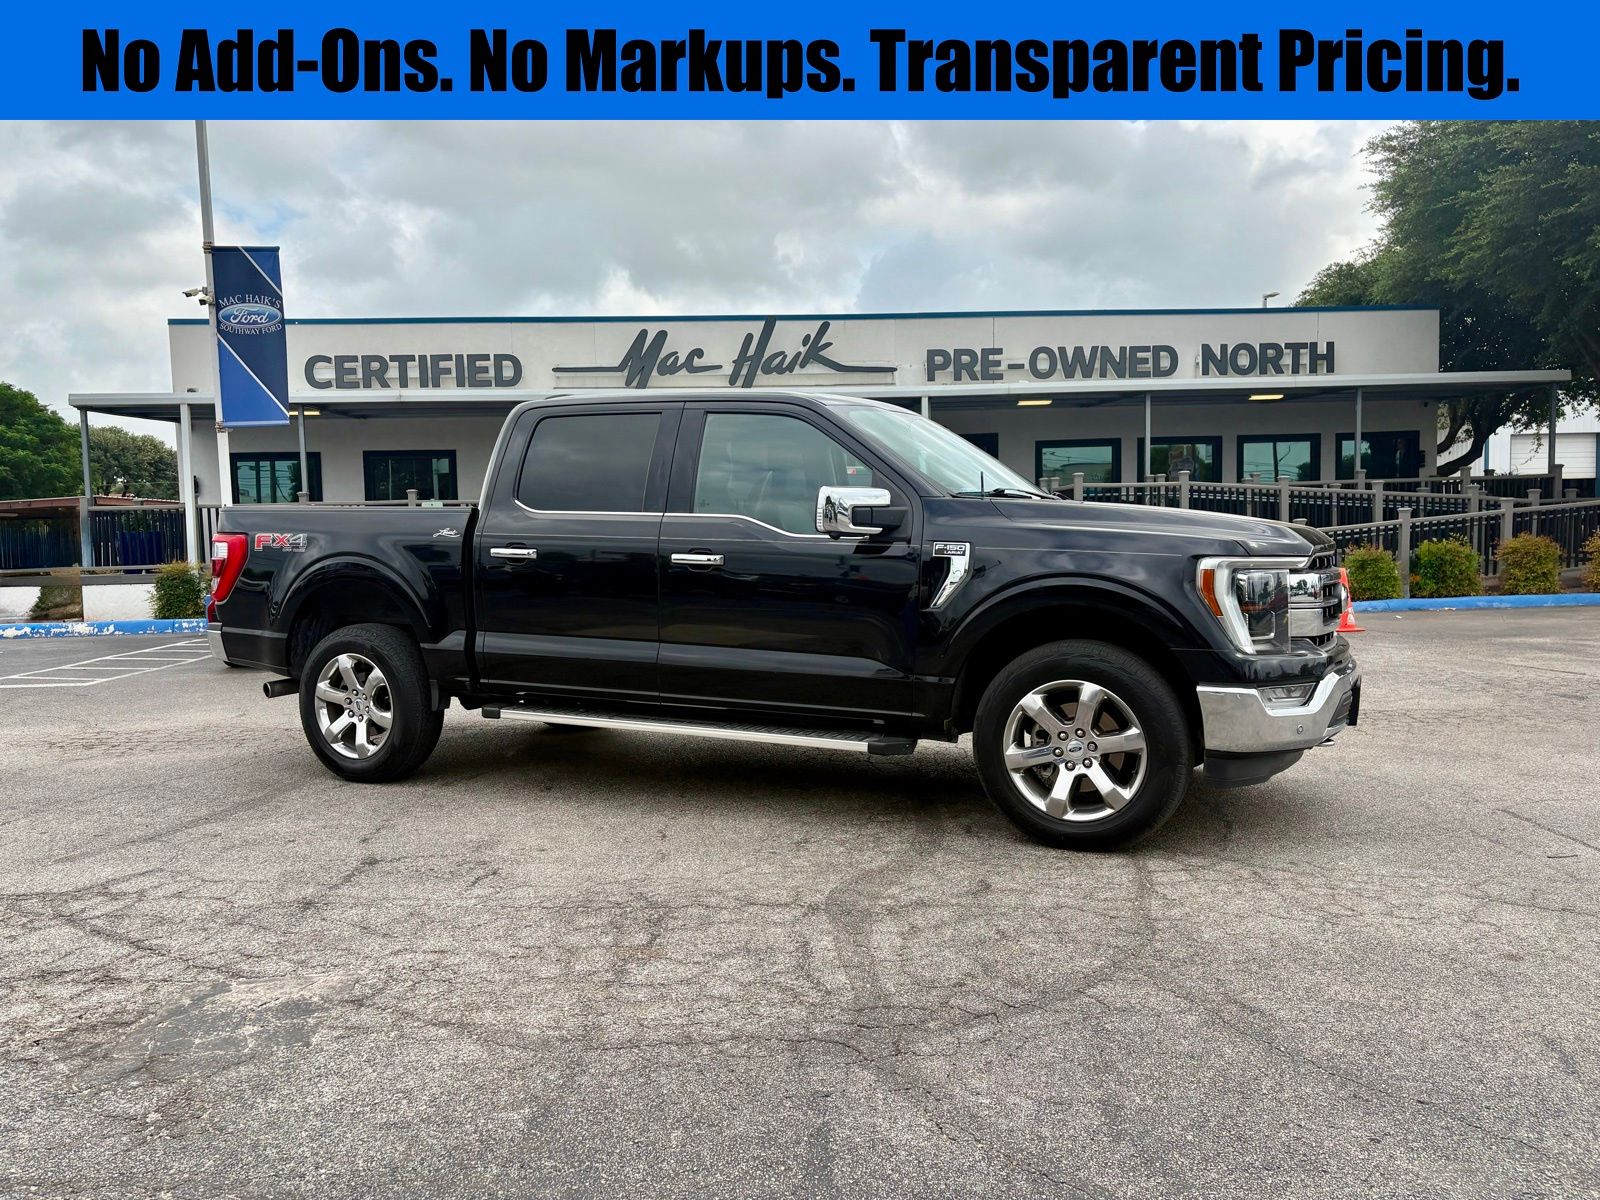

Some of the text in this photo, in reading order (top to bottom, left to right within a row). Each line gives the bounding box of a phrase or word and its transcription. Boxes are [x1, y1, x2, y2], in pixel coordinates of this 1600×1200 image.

[218, 294, 282, 309] MAC HAIK'S
[230, 307, 270, 323] Ford
[220, 323, 282, 335] SOUTHWAY FORD
[552, 316, 898, 389] Mac Haik
[926, 341, 1335, 382] PRE-OWNED NORTH
[304, 354, 523, 389] CERTIFIED
[254, 532, 307, 551] FX4
